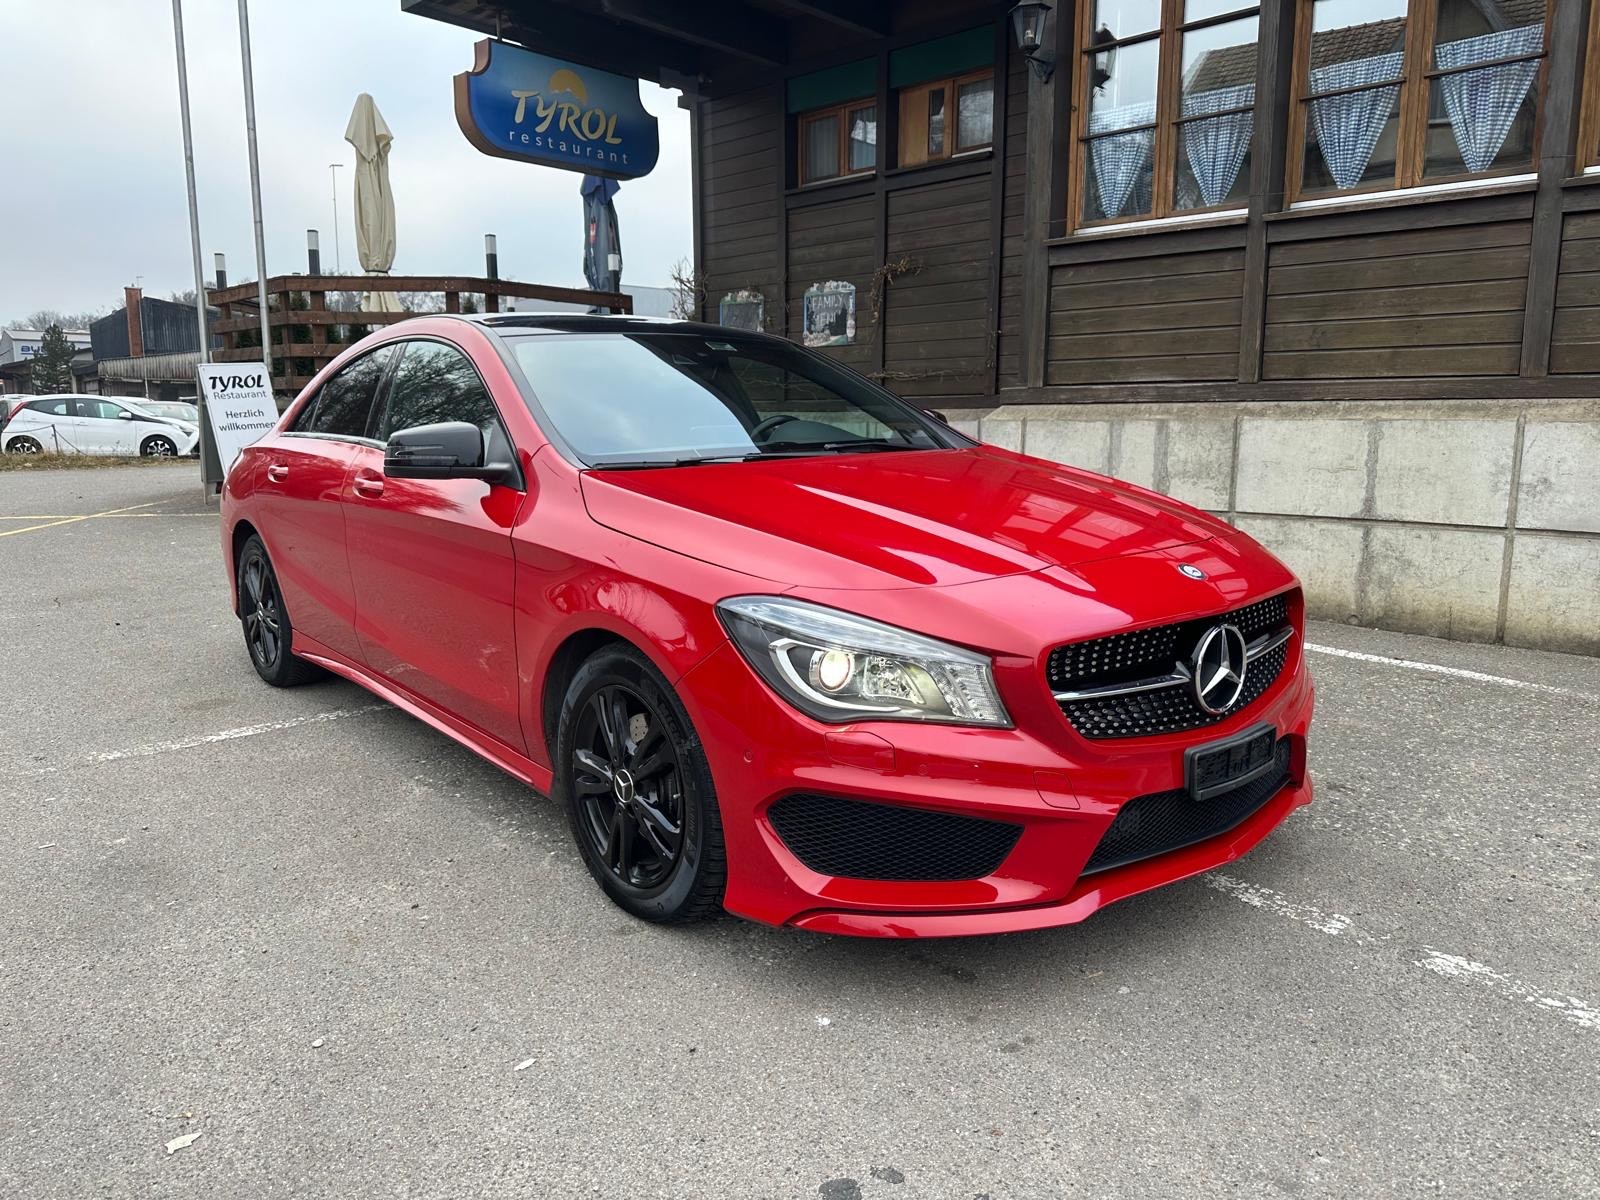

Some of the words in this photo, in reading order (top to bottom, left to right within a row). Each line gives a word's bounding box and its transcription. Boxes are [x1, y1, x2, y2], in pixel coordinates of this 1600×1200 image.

[511, 90, 623, 144] TYROL
[509, 130, 628, 165] restaurant
[209, 374, 264, 392] TYROL
[213, 390, 267, 400] Restaurant
[225, 409, 265, 418] Herzlich
[219, 421, 276, 431] willkommen
